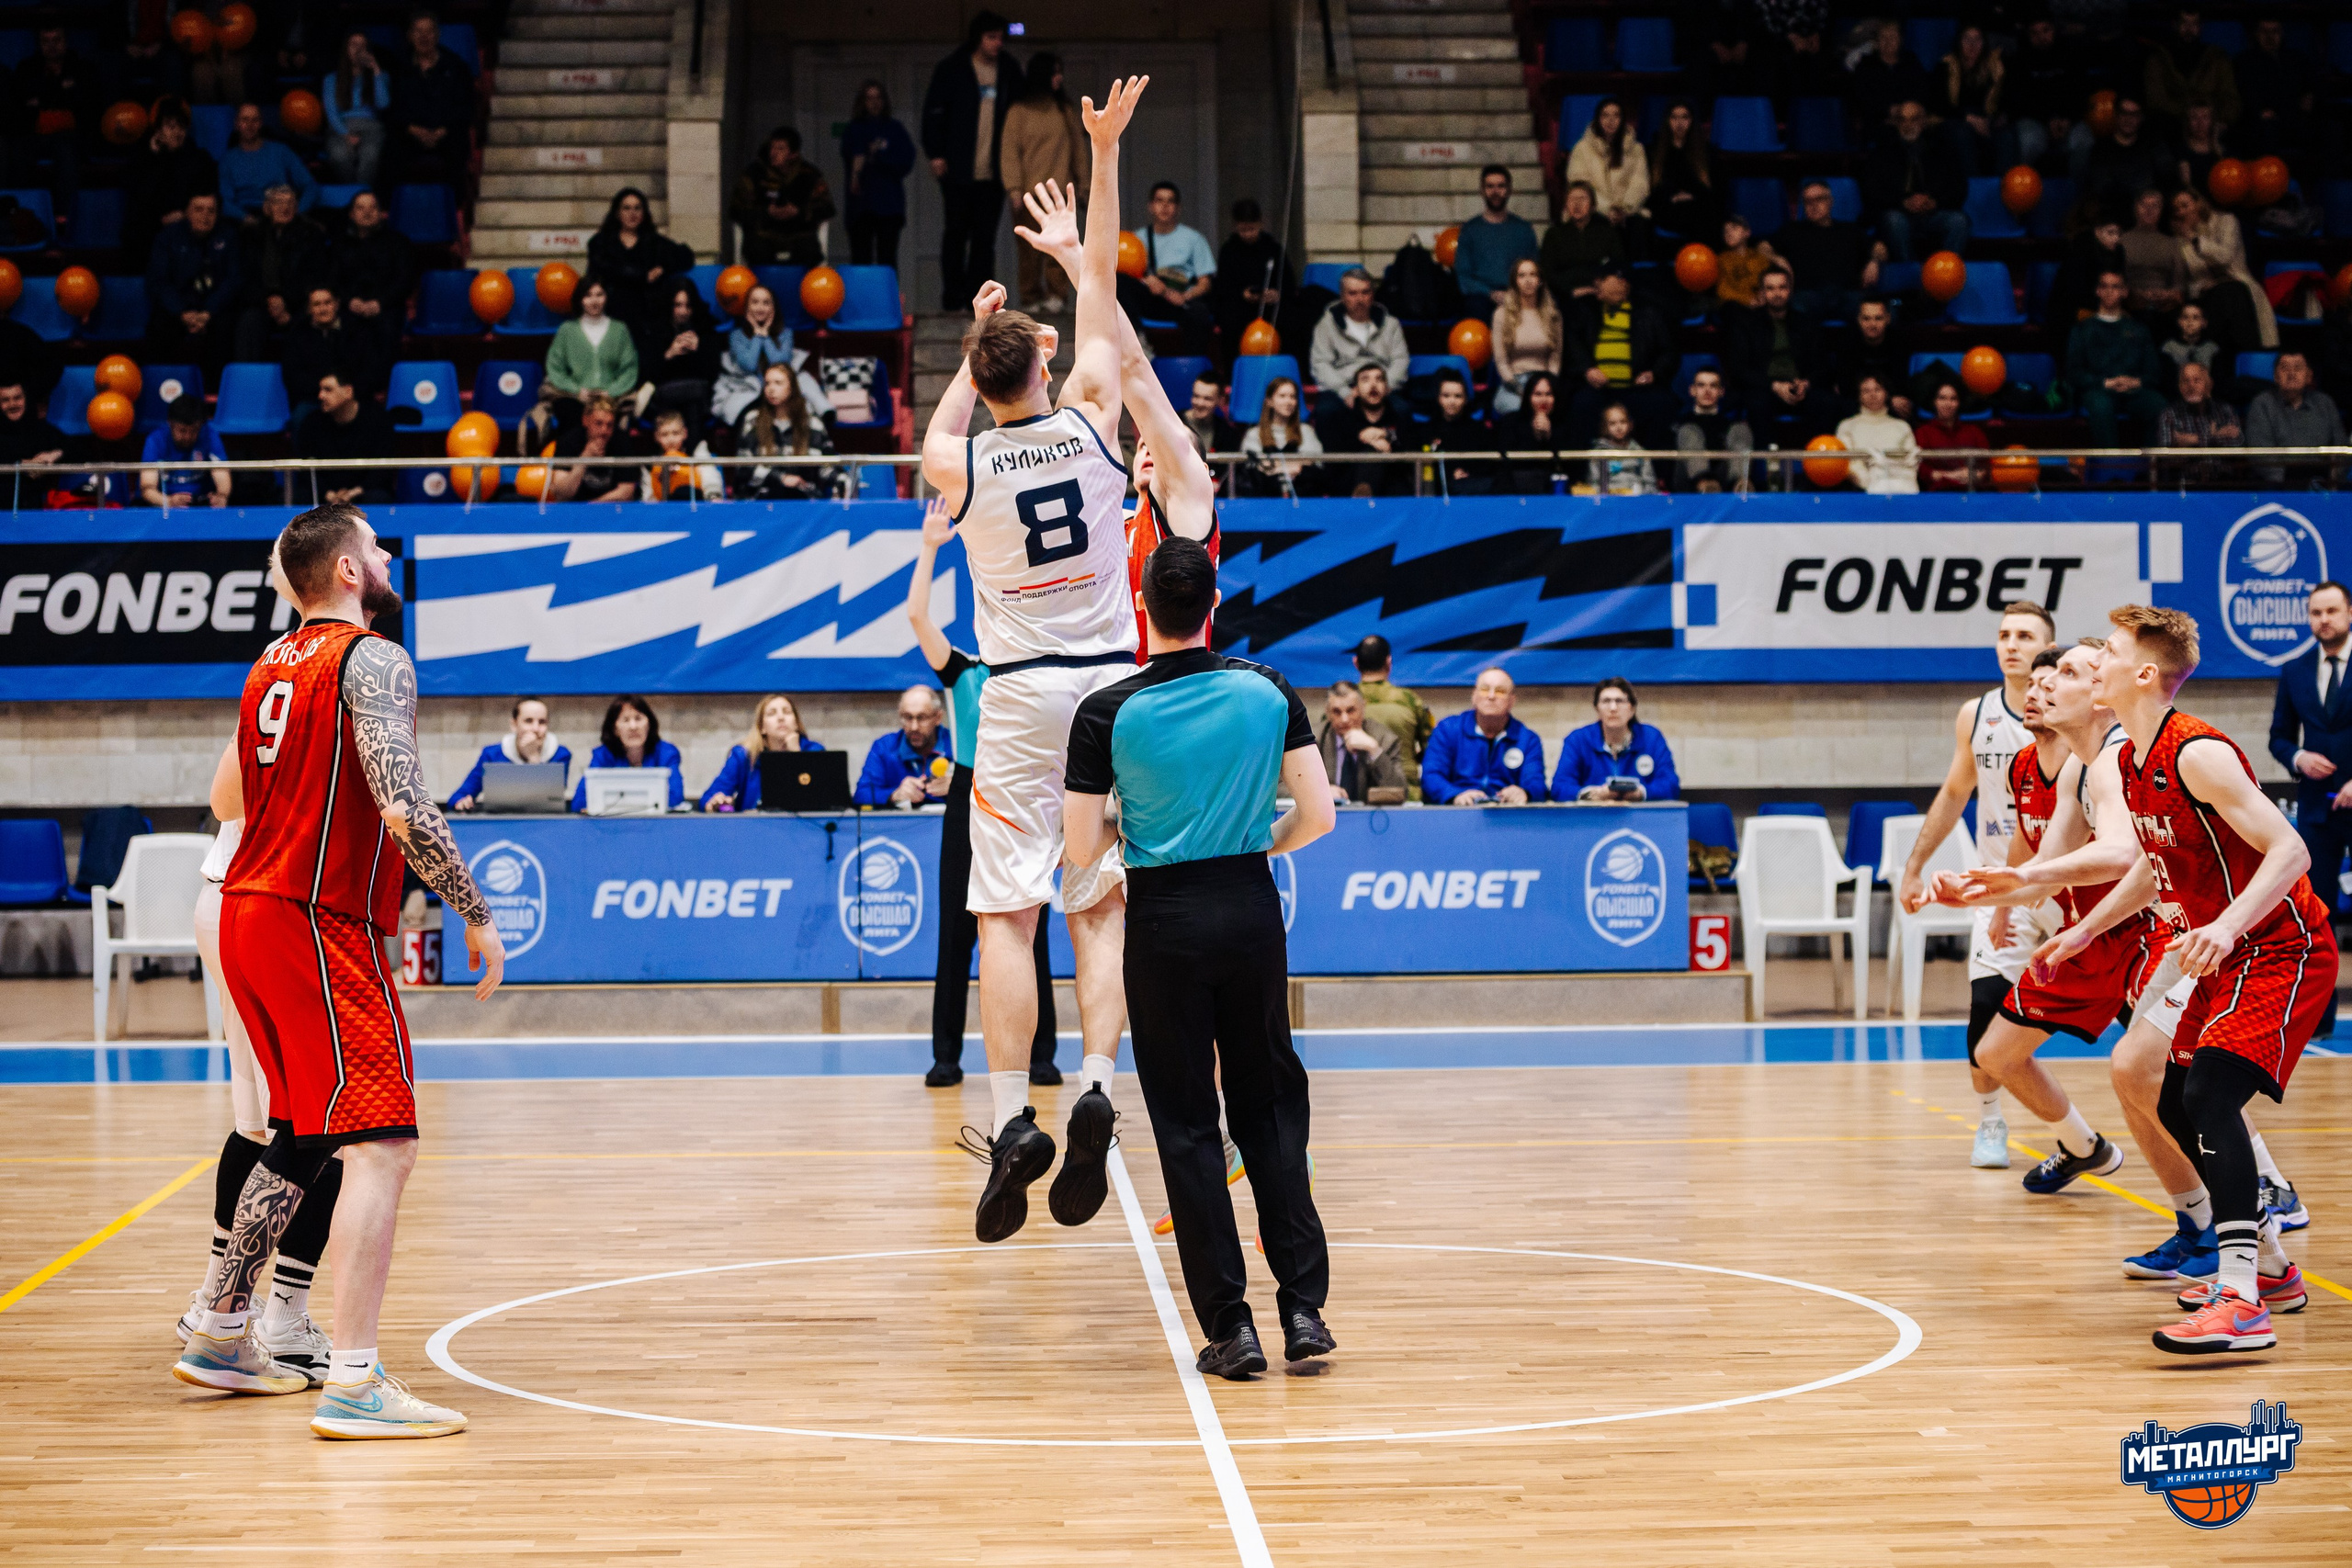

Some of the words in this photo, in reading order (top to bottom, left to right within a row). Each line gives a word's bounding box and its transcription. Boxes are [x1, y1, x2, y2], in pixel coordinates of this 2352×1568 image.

[991, 436, 1084, 476] КУЛИКОВ
[1015, 478, 1089, 568] 8
[1022, 585, 1069, 600] ПОДДЕРЖКИ
[1069, 581, 1097, 592] СПОРТА
[1776, 557, 2084, 614] FONBET
[2242, 579, 2305, 593] FONBET
[2250, 628, 2299, 641] ЛИГА
[256, 679, 295, 768] 9
[591, 878, 794, 919] FONBET
[1340, 869, 1542, 910] FONBET
[1694, 918, 1727, 970] 5
